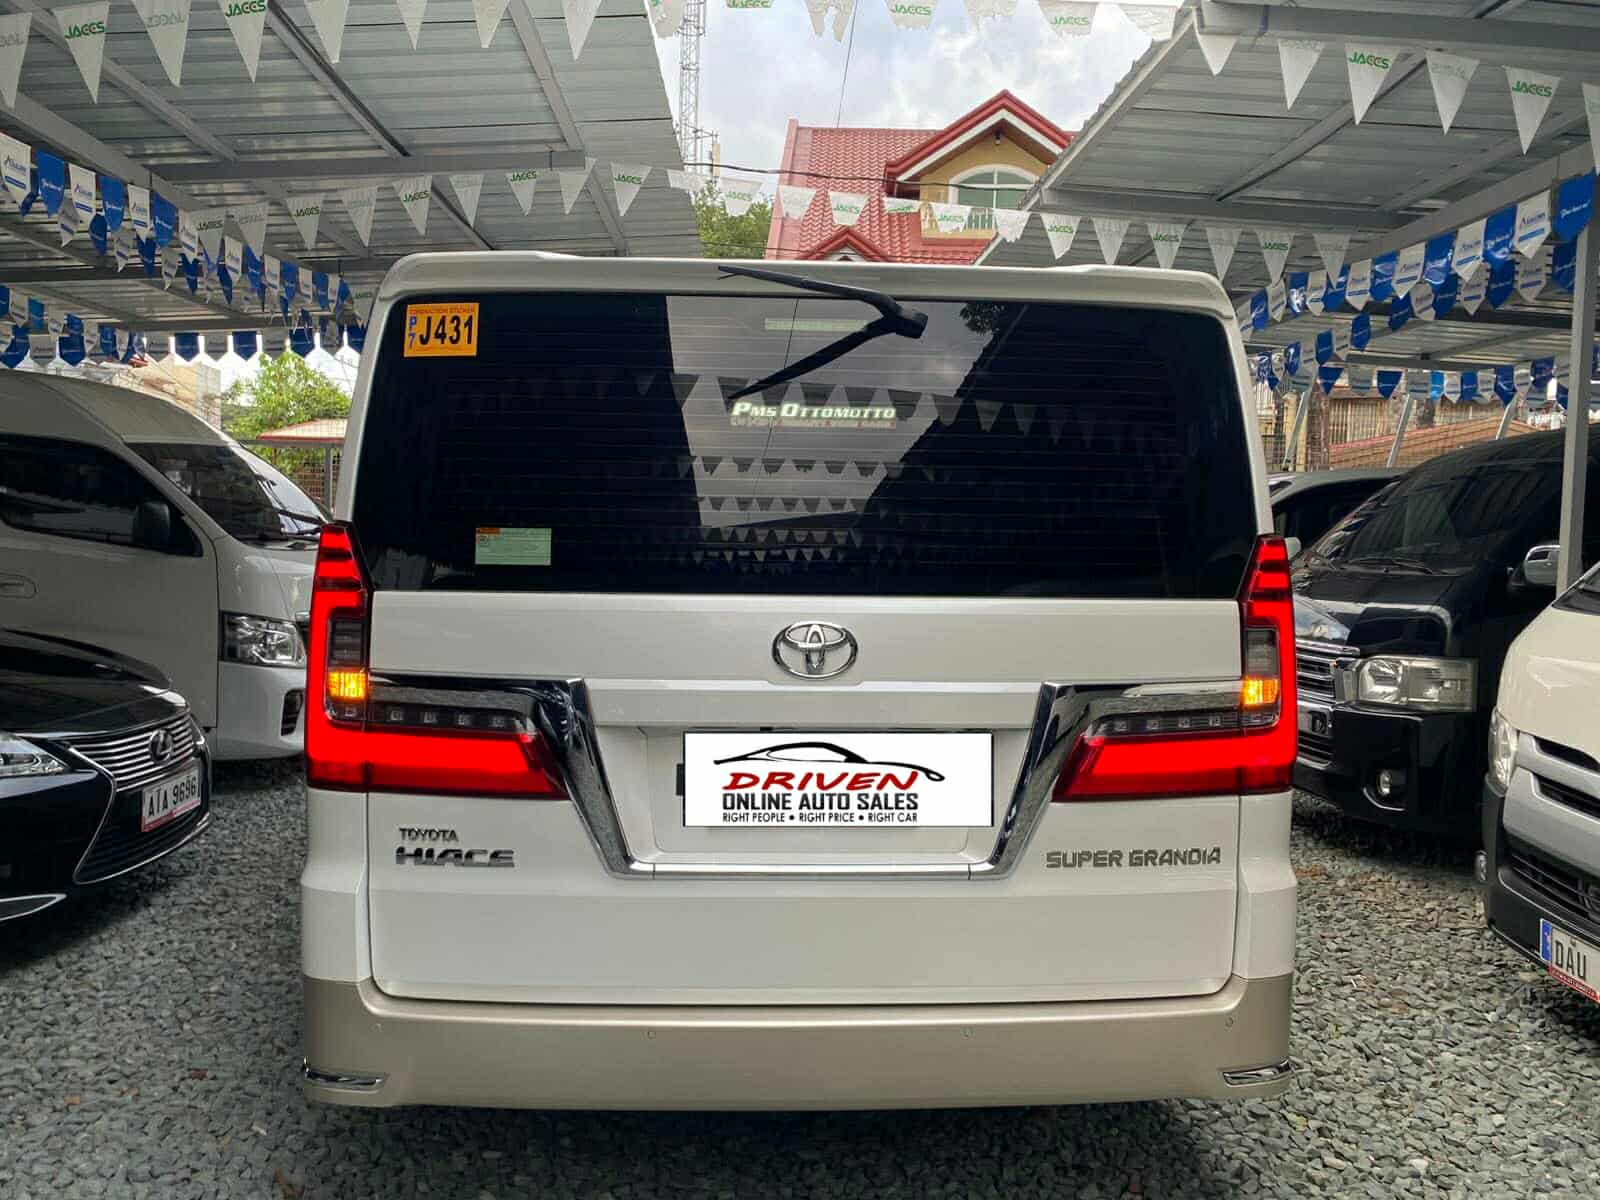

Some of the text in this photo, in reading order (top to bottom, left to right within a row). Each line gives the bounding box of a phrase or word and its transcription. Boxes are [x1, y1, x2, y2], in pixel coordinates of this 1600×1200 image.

[225, 0, 267, 17] JACCS
[889, 4, 931, 16] JACCS
[1051, 15, 1090, 26] JACCS
[64, 21, 105, 39] JACCS
[1348, 51, 1390, 70] JACCS
[1511, 80, 1553, 97] JACCS
[402, 190, 430, 203] JACCS
[419, 314, 473, 345] J431
[399, 828, 459, 842] TOYOTA
[396, 846, 515, 868] HIACE
[1046, 847, 1222, 868] SUPER GRANDIA
[1555, 939, 1587, 981] DAU
